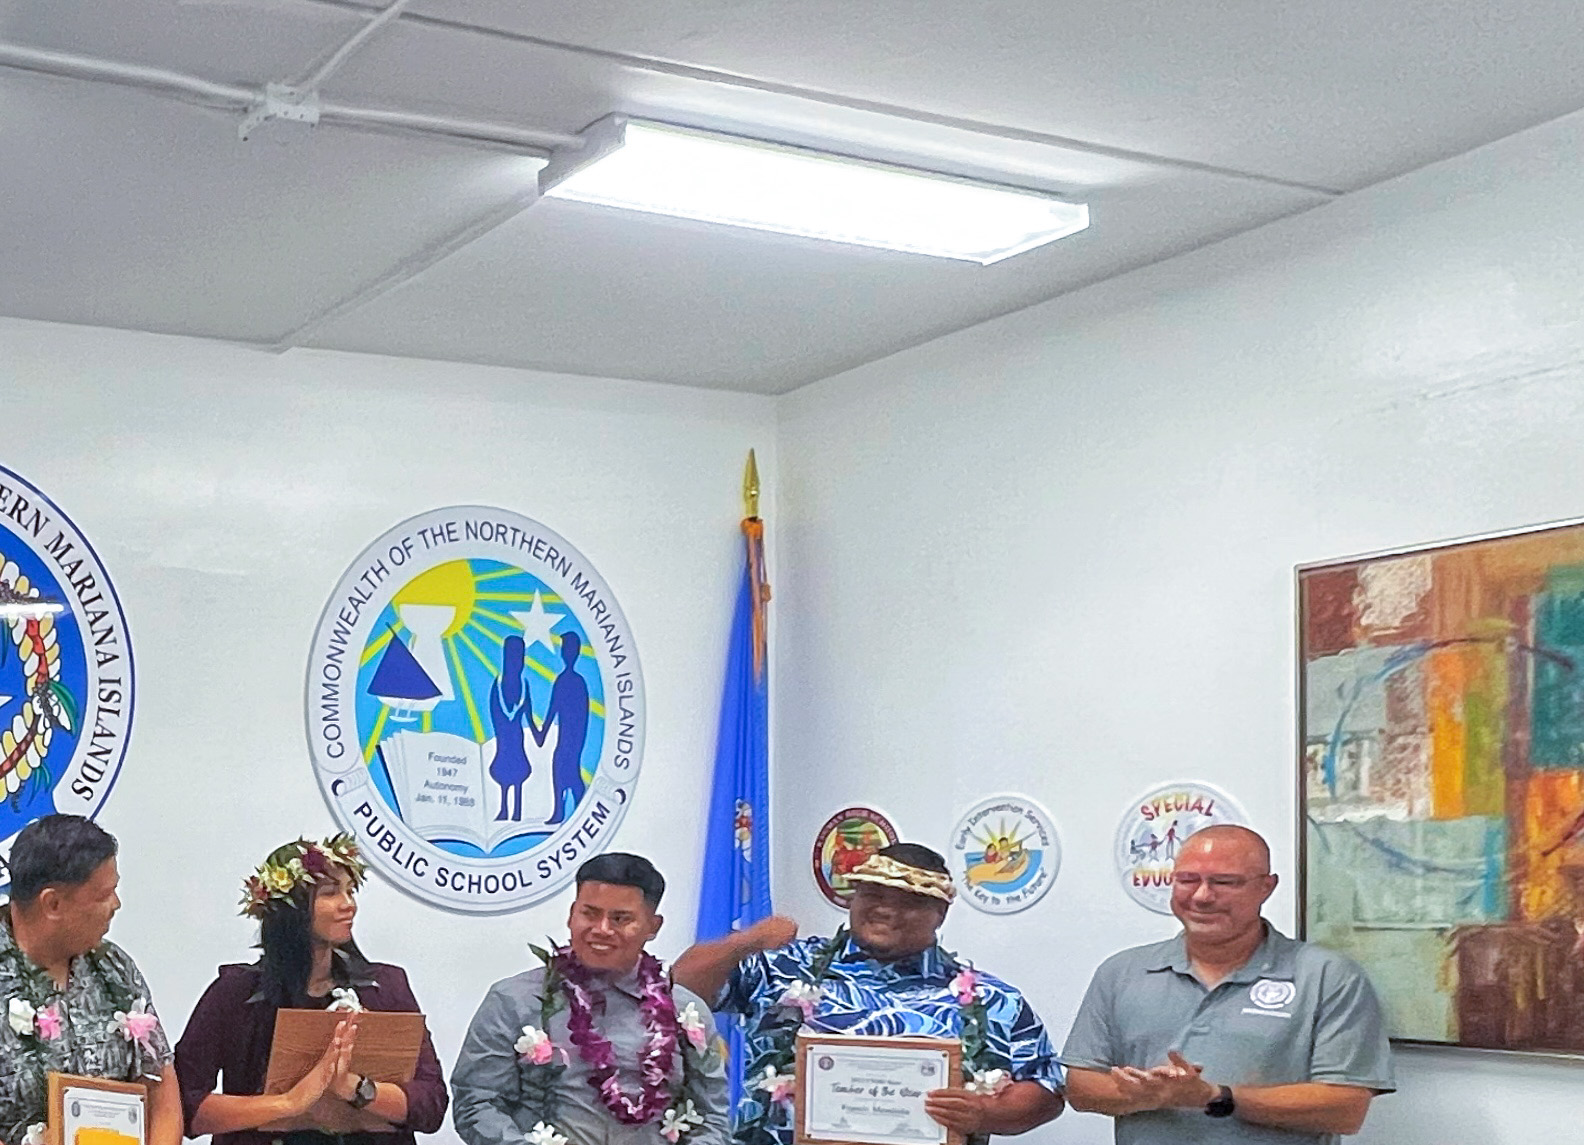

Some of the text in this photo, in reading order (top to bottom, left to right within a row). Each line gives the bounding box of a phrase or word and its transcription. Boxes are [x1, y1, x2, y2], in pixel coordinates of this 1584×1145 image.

[42, 531, 120, 672] MARIANA
[322, 520, 635, 771] COMMONWEALTH OF THE NORTHERN MARIANA ISLANDS
[71, 676, 122, 801] ISLANDS
[353, 801, 611, 895] PUBLIC SCHOOL SYSTEM
